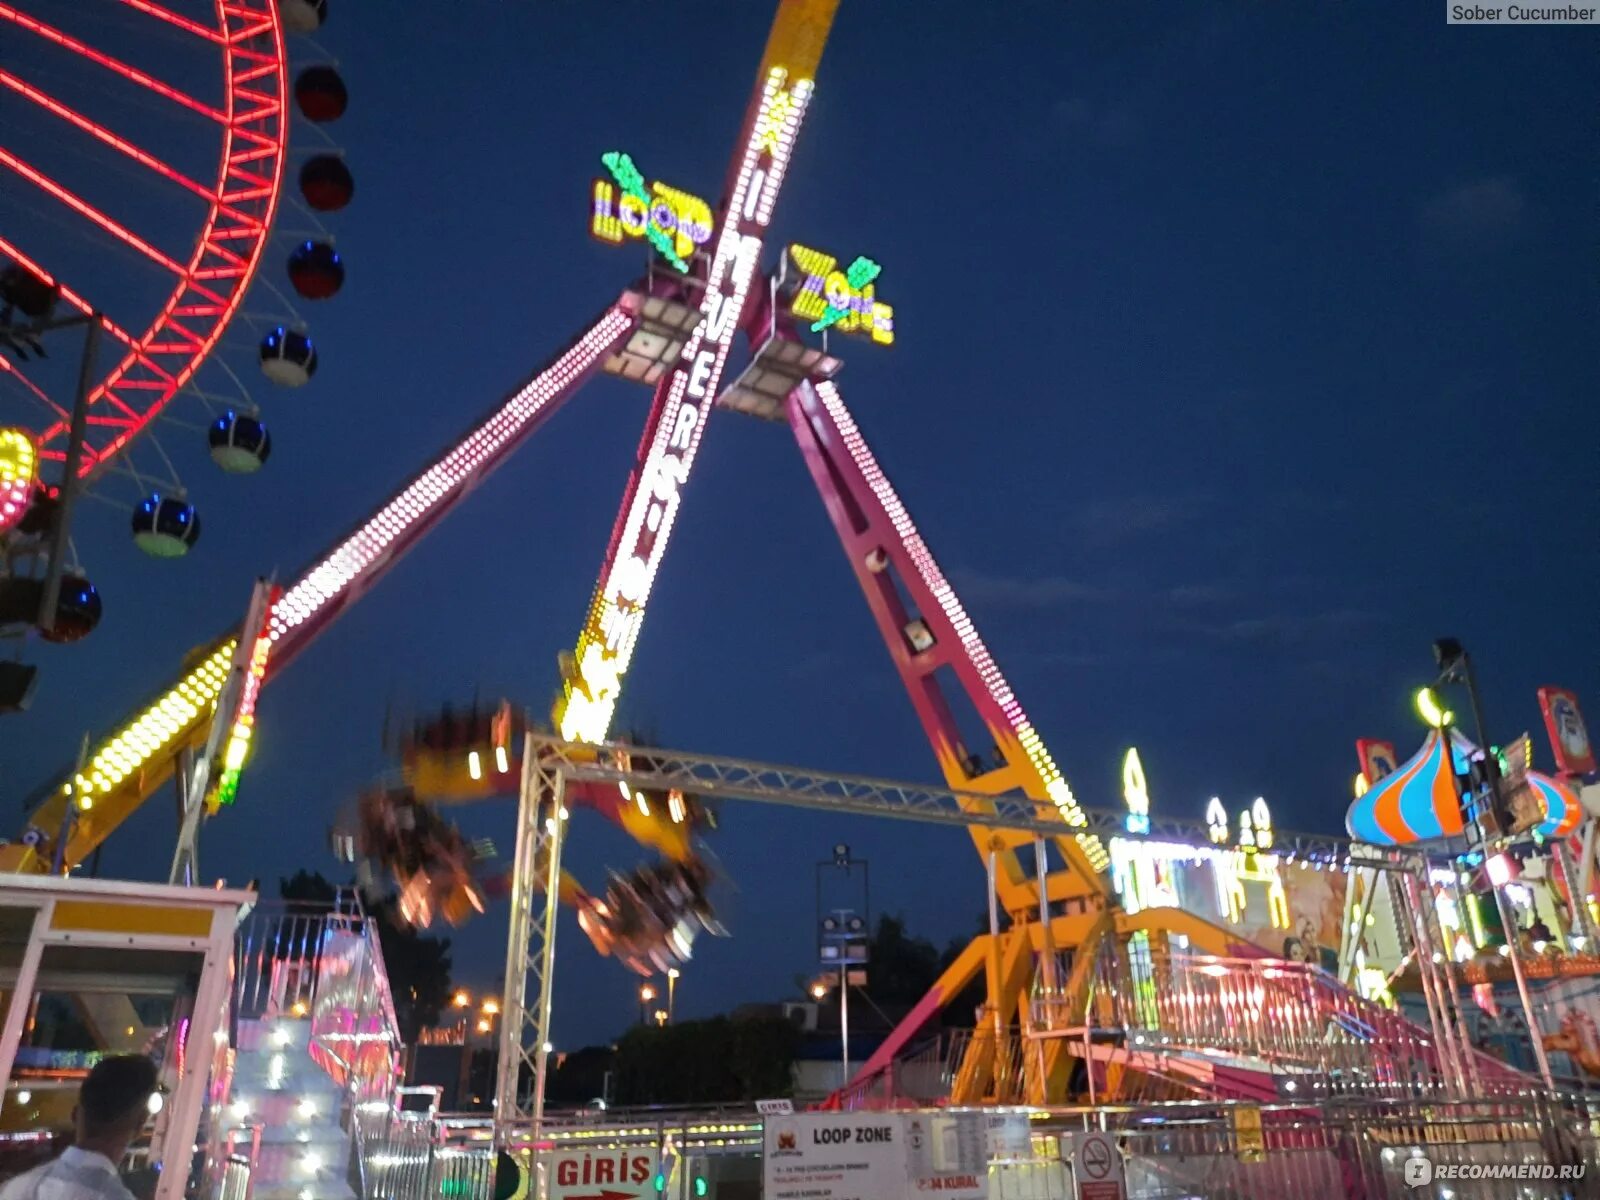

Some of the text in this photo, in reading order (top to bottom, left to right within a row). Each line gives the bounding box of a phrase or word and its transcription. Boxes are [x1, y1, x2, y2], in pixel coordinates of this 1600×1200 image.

[591, 178, 714, 258] LOOP
[790, 243, 895, 344] ZONE
[813, 1126, 892, 1145] LOOP ZONE
[557, 1151, 651, 1186] GİRİŞ
